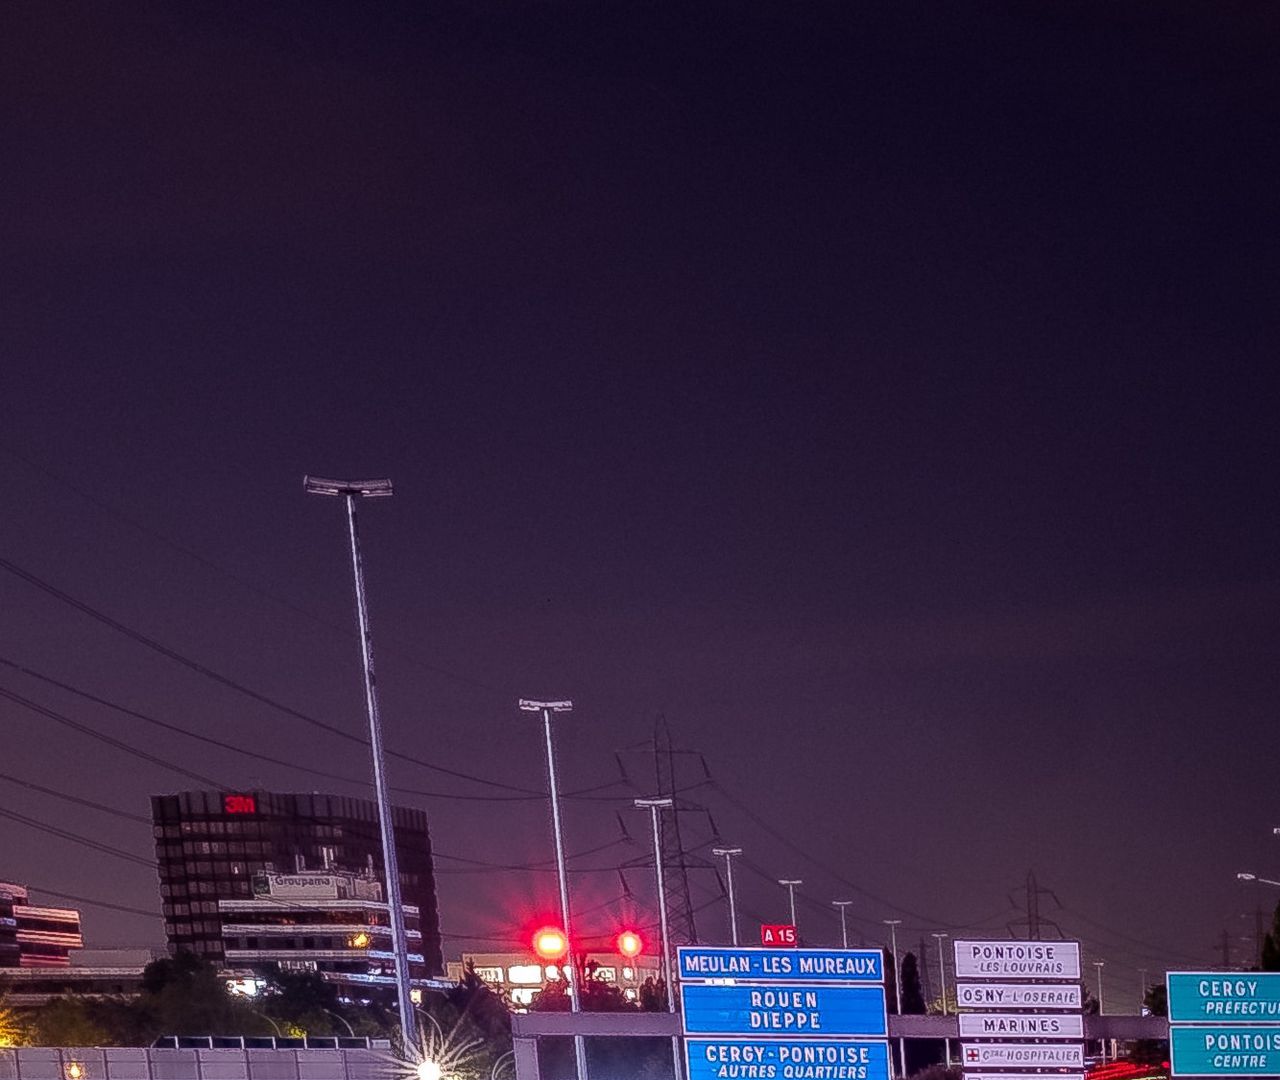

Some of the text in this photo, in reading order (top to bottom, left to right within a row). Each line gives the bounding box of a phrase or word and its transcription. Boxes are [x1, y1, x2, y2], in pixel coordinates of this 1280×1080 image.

[225, 796, 255, 814] 3M
[275, 876, 330, 888] Groupama
[765, 929, 795, 942] A 15
[972, 946, 1054, 960] PONTOISE
[800, 957, 877, 974] MUREAUX
[1004, 962, 1062, 973] LOUVRAIS
[1200, 981, 1257, 996] CERGY
[751, 992, 817, 1008] ROUEN
[751, 1012, 821, 1029] DIEPPE
[984, 1019, 1059, 1033] MARINES
[1006, 1050, 1080, 1061] HOSPITALIER
[784, 1066, 867, 1079] QUARTIERS
